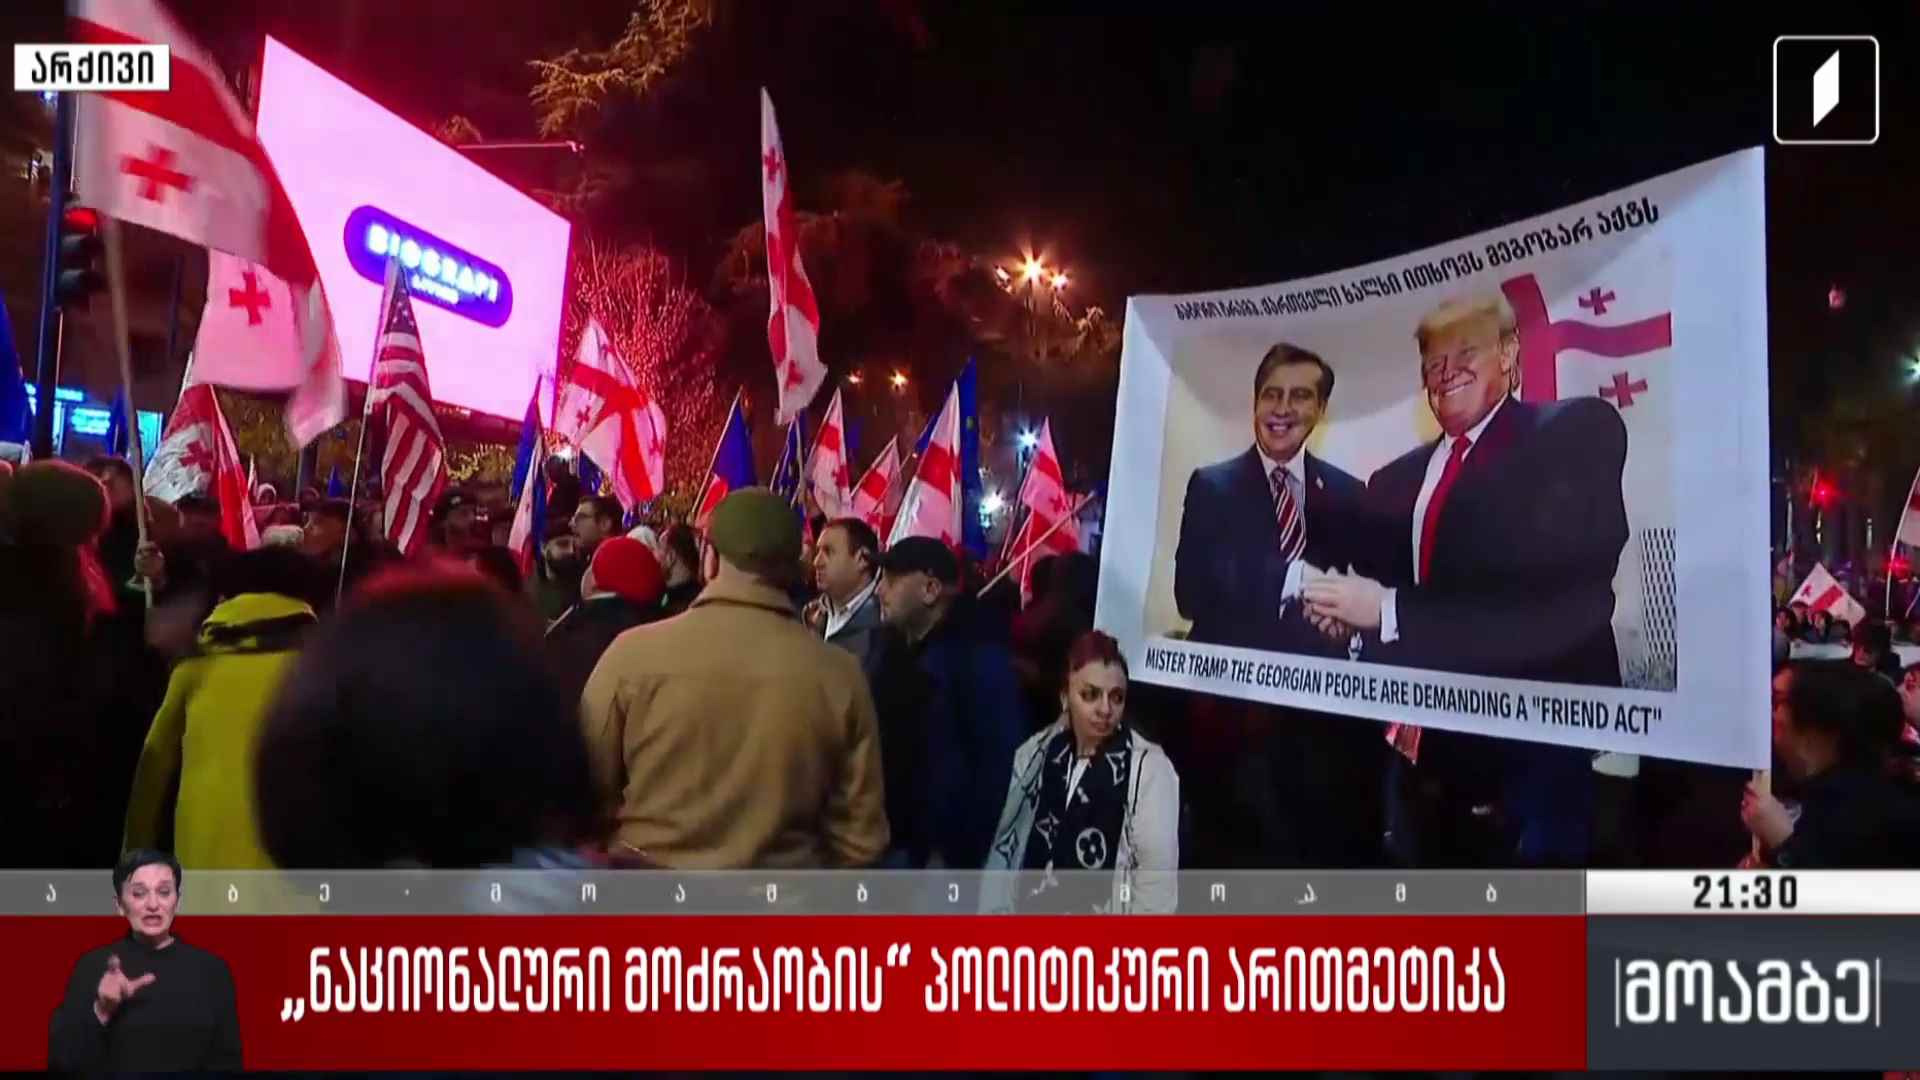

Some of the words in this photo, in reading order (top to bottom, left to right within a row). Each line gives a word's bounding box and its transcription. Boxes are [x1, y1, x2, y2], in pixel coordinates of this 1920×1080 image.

[1261, 286, 1342, 315] ქართველი
[1341, 272, 1402, 304] ხალხი
[1402, 250, 1484, 291] ითხოვს
[1486, 217, 1593, 267] მეგობარ
[1597, 197, 1659, 235] აქტს
[1145, 648, 1186, 674] MISTER
[1188, 654, 1229, 678] TRAMP
[1231, 659, 1253, 683] THE
[1256, 664, 1323, 695] GEORGIAN
[1324, 672, 1378, 702] PEOPLE
[1381, 678, 1409, 706] ARE
[1413, 682, 1512, 719] DEMANDING
[1515, 696, 1528, 721] A
[1533, 695, 1609, 730] "FRIEND
[1614, 705, 1662, 735] ACT"
